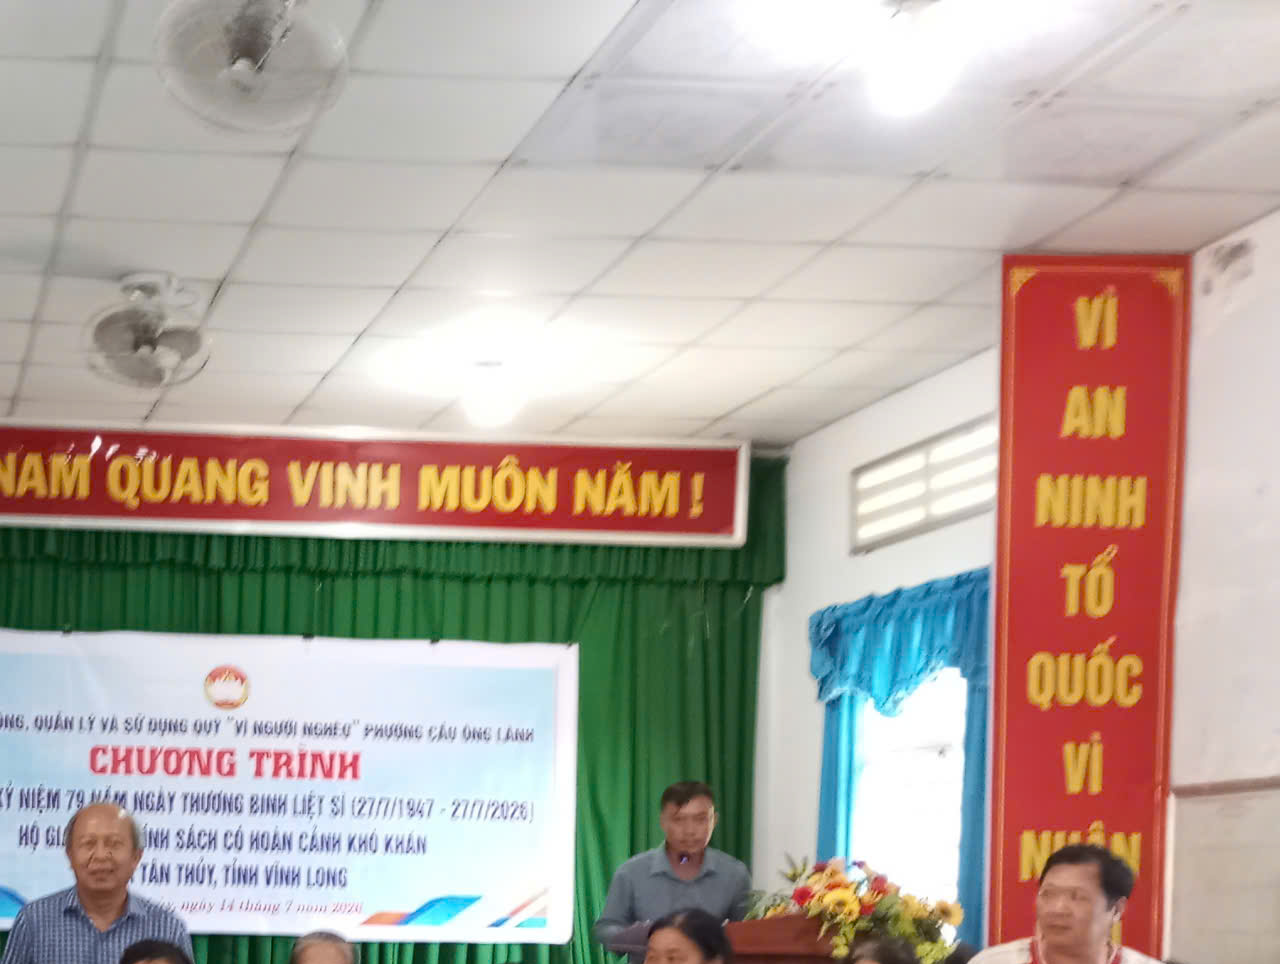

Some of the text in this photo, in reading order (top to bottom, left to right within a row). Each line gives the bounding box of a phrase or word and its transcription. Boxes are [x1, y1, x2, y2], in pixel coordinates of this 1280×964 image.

[1061, 385, 1126, 439] AN
[107, 454, 271, 510] QUANG
[287, 460, 402, 510] VINH
[417, 454, 559, 515] MUÔN
[572, 460, 681, 519] NĂM
[1034, 473, 1148, 529] NINH
[1060, 544, 1119, 617] TỔ
[1027, 635, 1143, 711] QUỐC
[89, 744, 362, 780] CHƯƠNG TRÌNH
[19, 784, 61, 814] NIỆM
[65, 788, 85, 811] 79
[133, 786, 176, 814] NGÀY
[181, 790, 245, 815] THƯƠNG
[249, 793, 288, 816] BINH
[293, 790, 324, 822] LIỆT
[18, 820, 40, 853] HỘ
[175, 823, 218, 852] SÁCH
[223, 824, 245, 851] CÓ
[249, 825, 294, 853] HOÀN
[298, 822, 342, 854] CẢNH
[346, 828, 380, 855] KHÓ
[140, 860, 170, 885] TÂN
[222, 857, 260, 887] TỈNH
[264, 861, 302, 887] VĨNH
[306, 866, 348, 889] LONG
